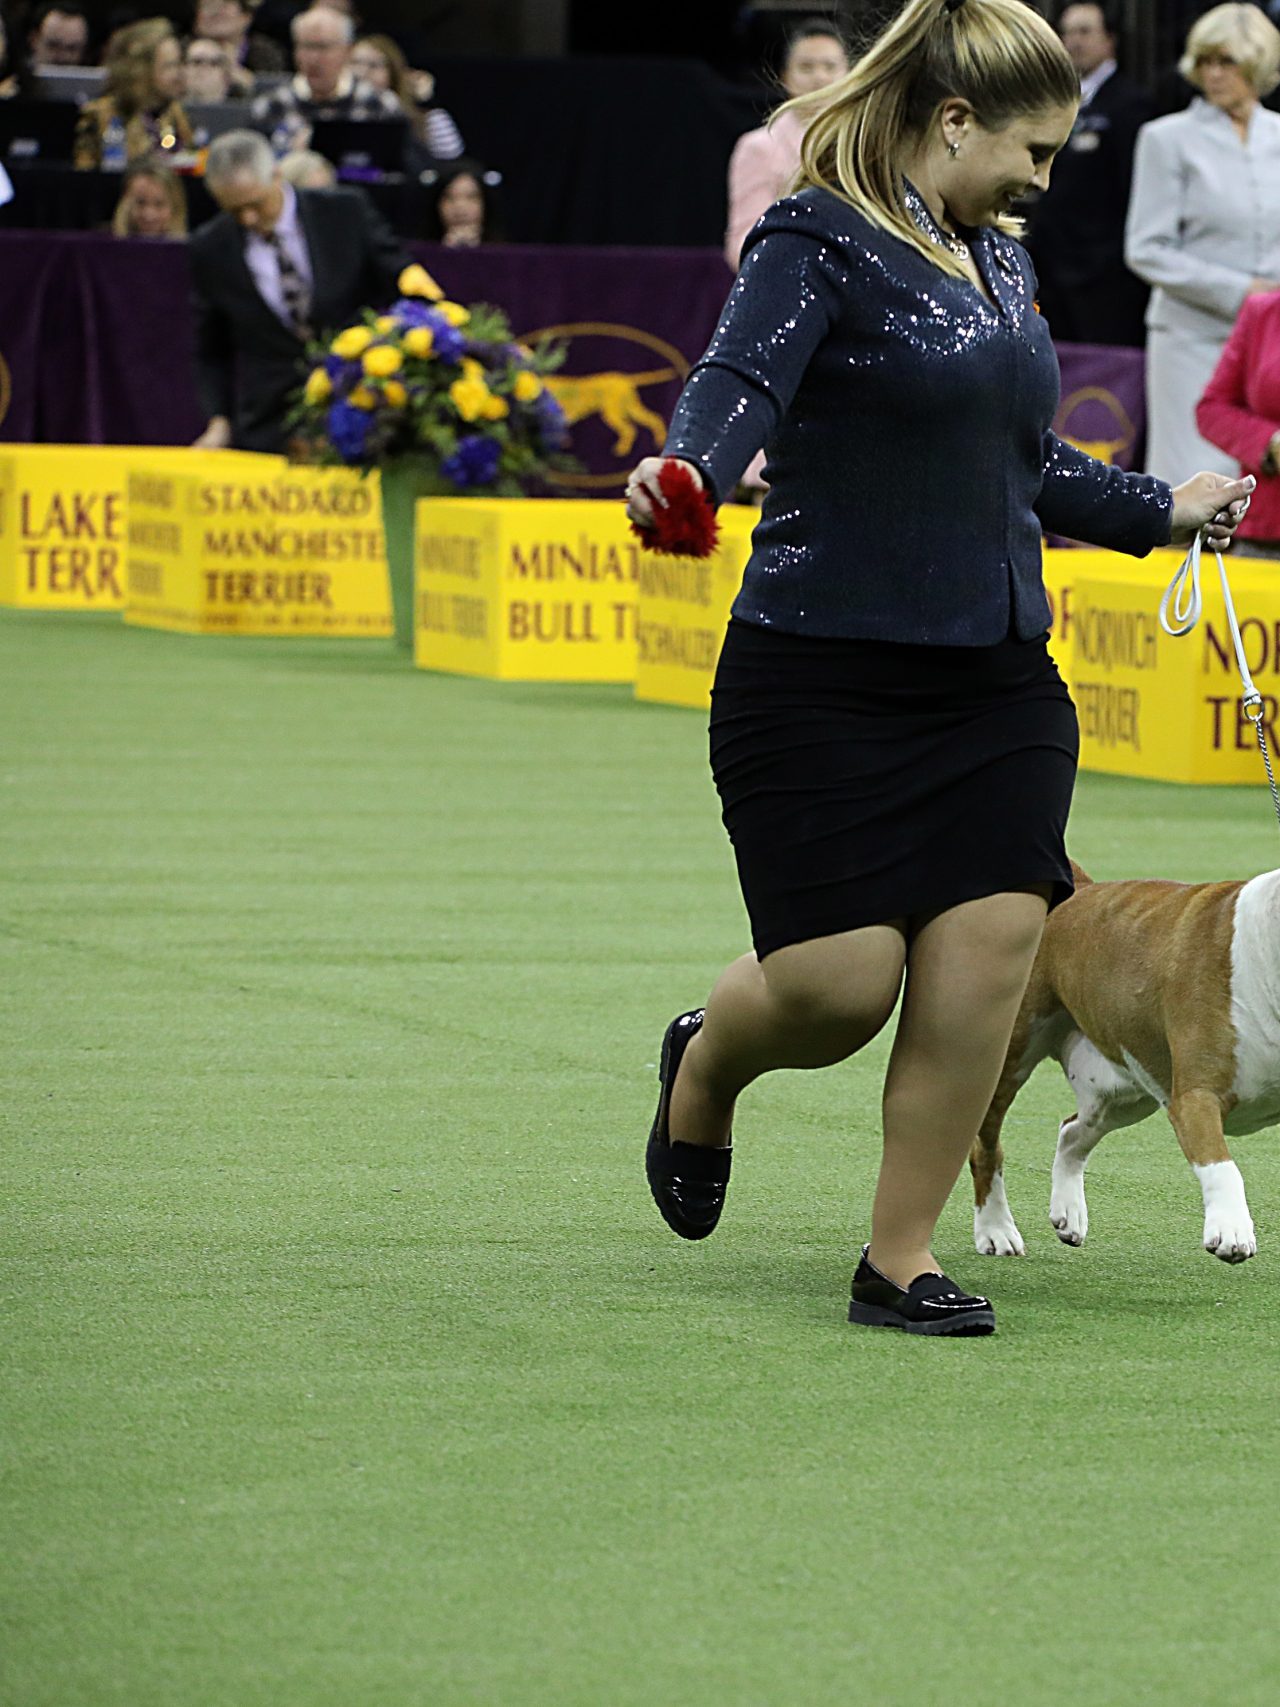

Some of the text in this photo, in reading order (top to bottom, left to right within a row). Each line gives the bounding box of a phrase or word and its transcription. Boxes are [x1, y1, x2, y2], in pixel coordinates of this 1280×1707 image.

[20, 489, 124, 541] LAKE
[19, 544, 123, 600] TERR
[203, 568, 336, 610] TERRIER
[508, 599, 599, 643] BULL
